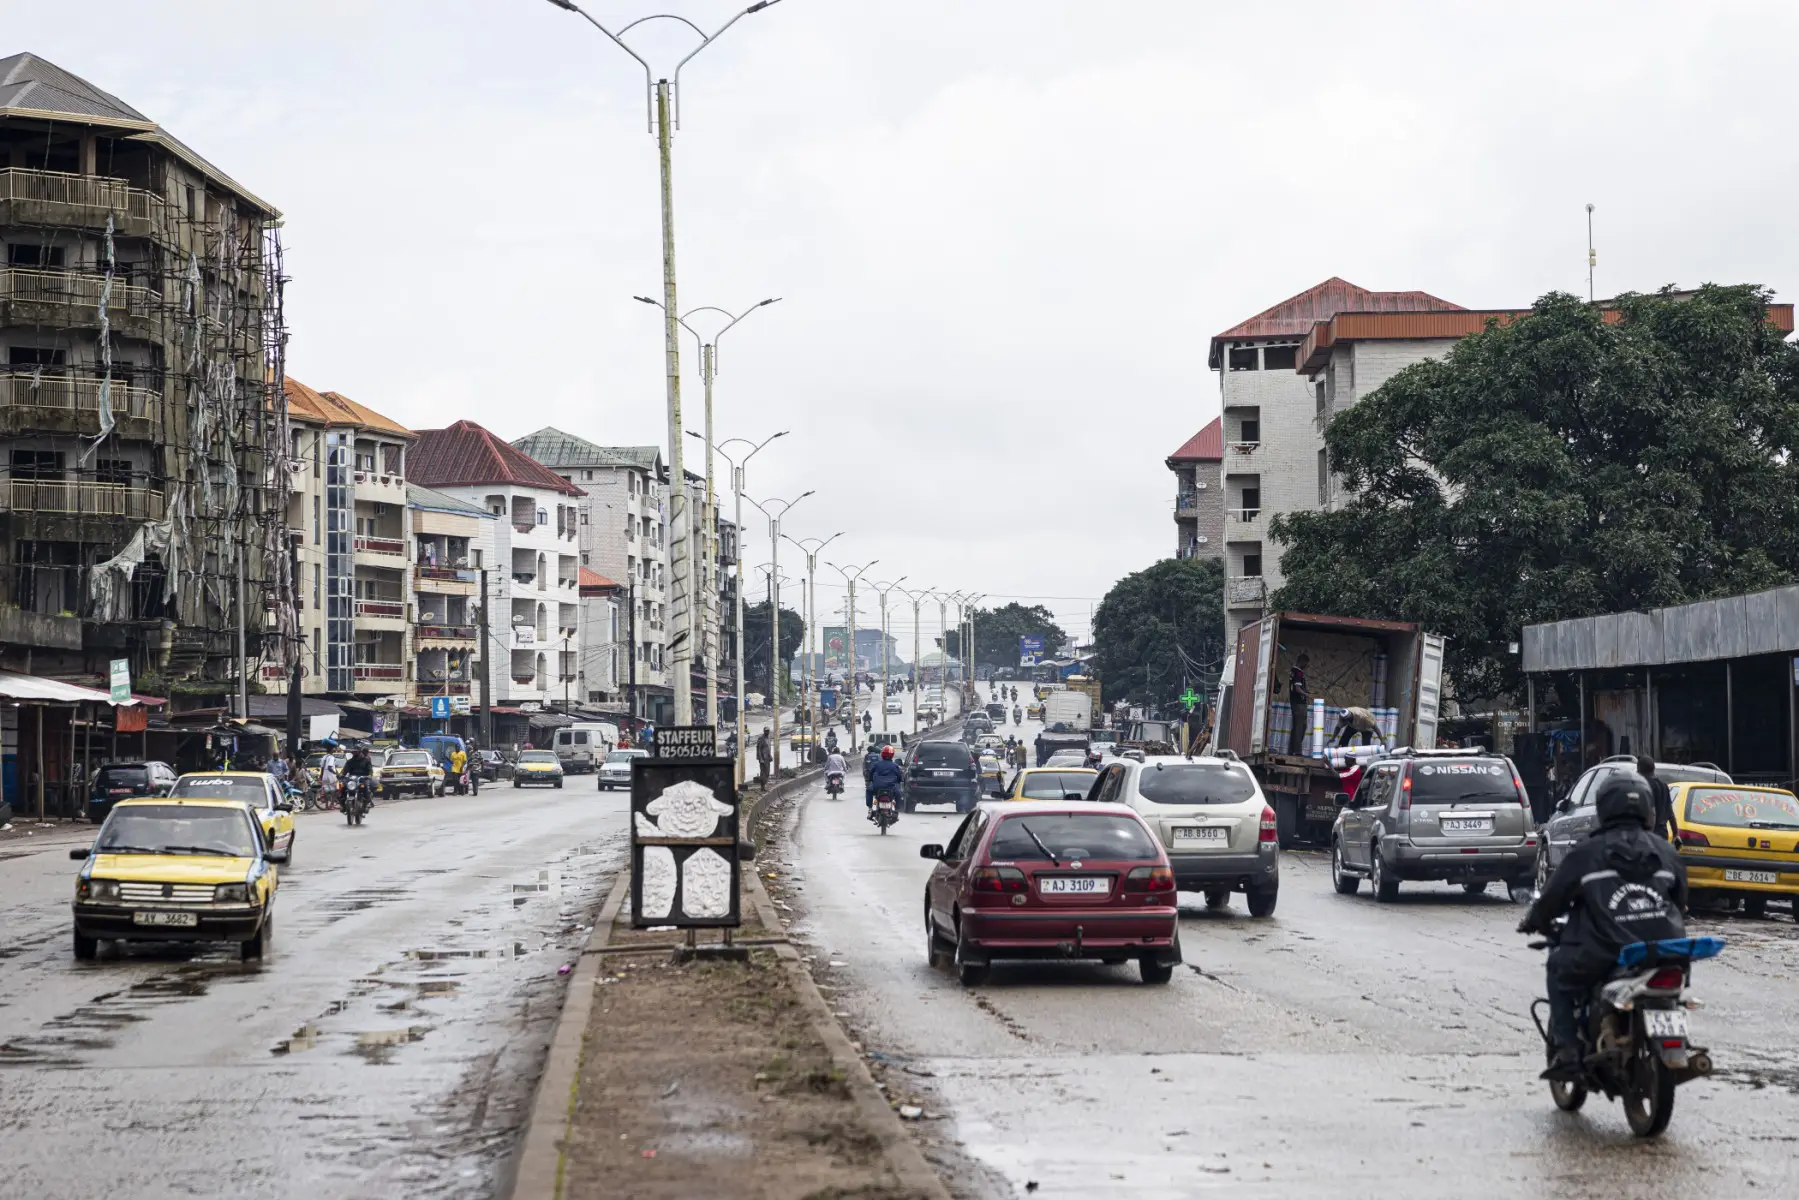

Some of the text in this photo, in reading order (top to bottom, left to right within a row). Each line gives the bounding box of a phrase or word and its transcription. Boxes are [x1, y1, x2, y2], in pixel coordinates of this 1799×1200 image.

[657, 730, 713, 744] STAFFEUR
[659, 744, 715, 758] 625051364
[1437, 766, 1487, 775] NISSAN
[1734, 802, 1757, 818] 10
[1463, 820, 1482, 829] 3449
[1183, 828, 1193, 838] AB
[1732, 871, 1769, 881] BE 2614
[1052, 879, 1095, 891] AJ 3109
